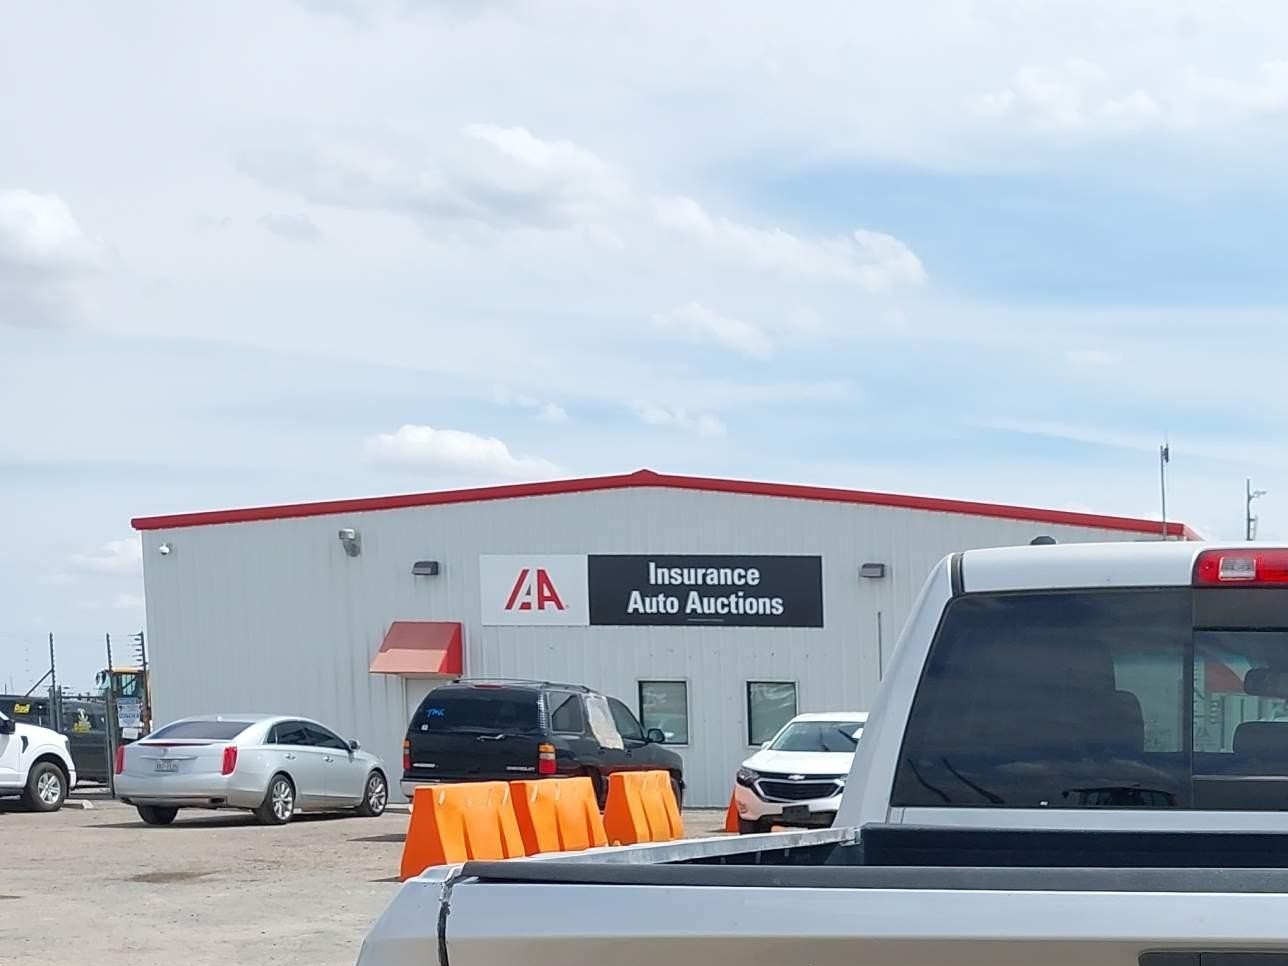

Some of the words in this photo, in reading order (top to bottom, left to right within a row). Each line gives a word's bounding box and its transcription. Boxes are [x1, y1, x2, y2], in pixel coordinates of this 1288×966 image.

[648, 562, 761, 586] Insurance
[627, 591, 679, 614] Auto
[685, 591, 784, 615] Auctions
